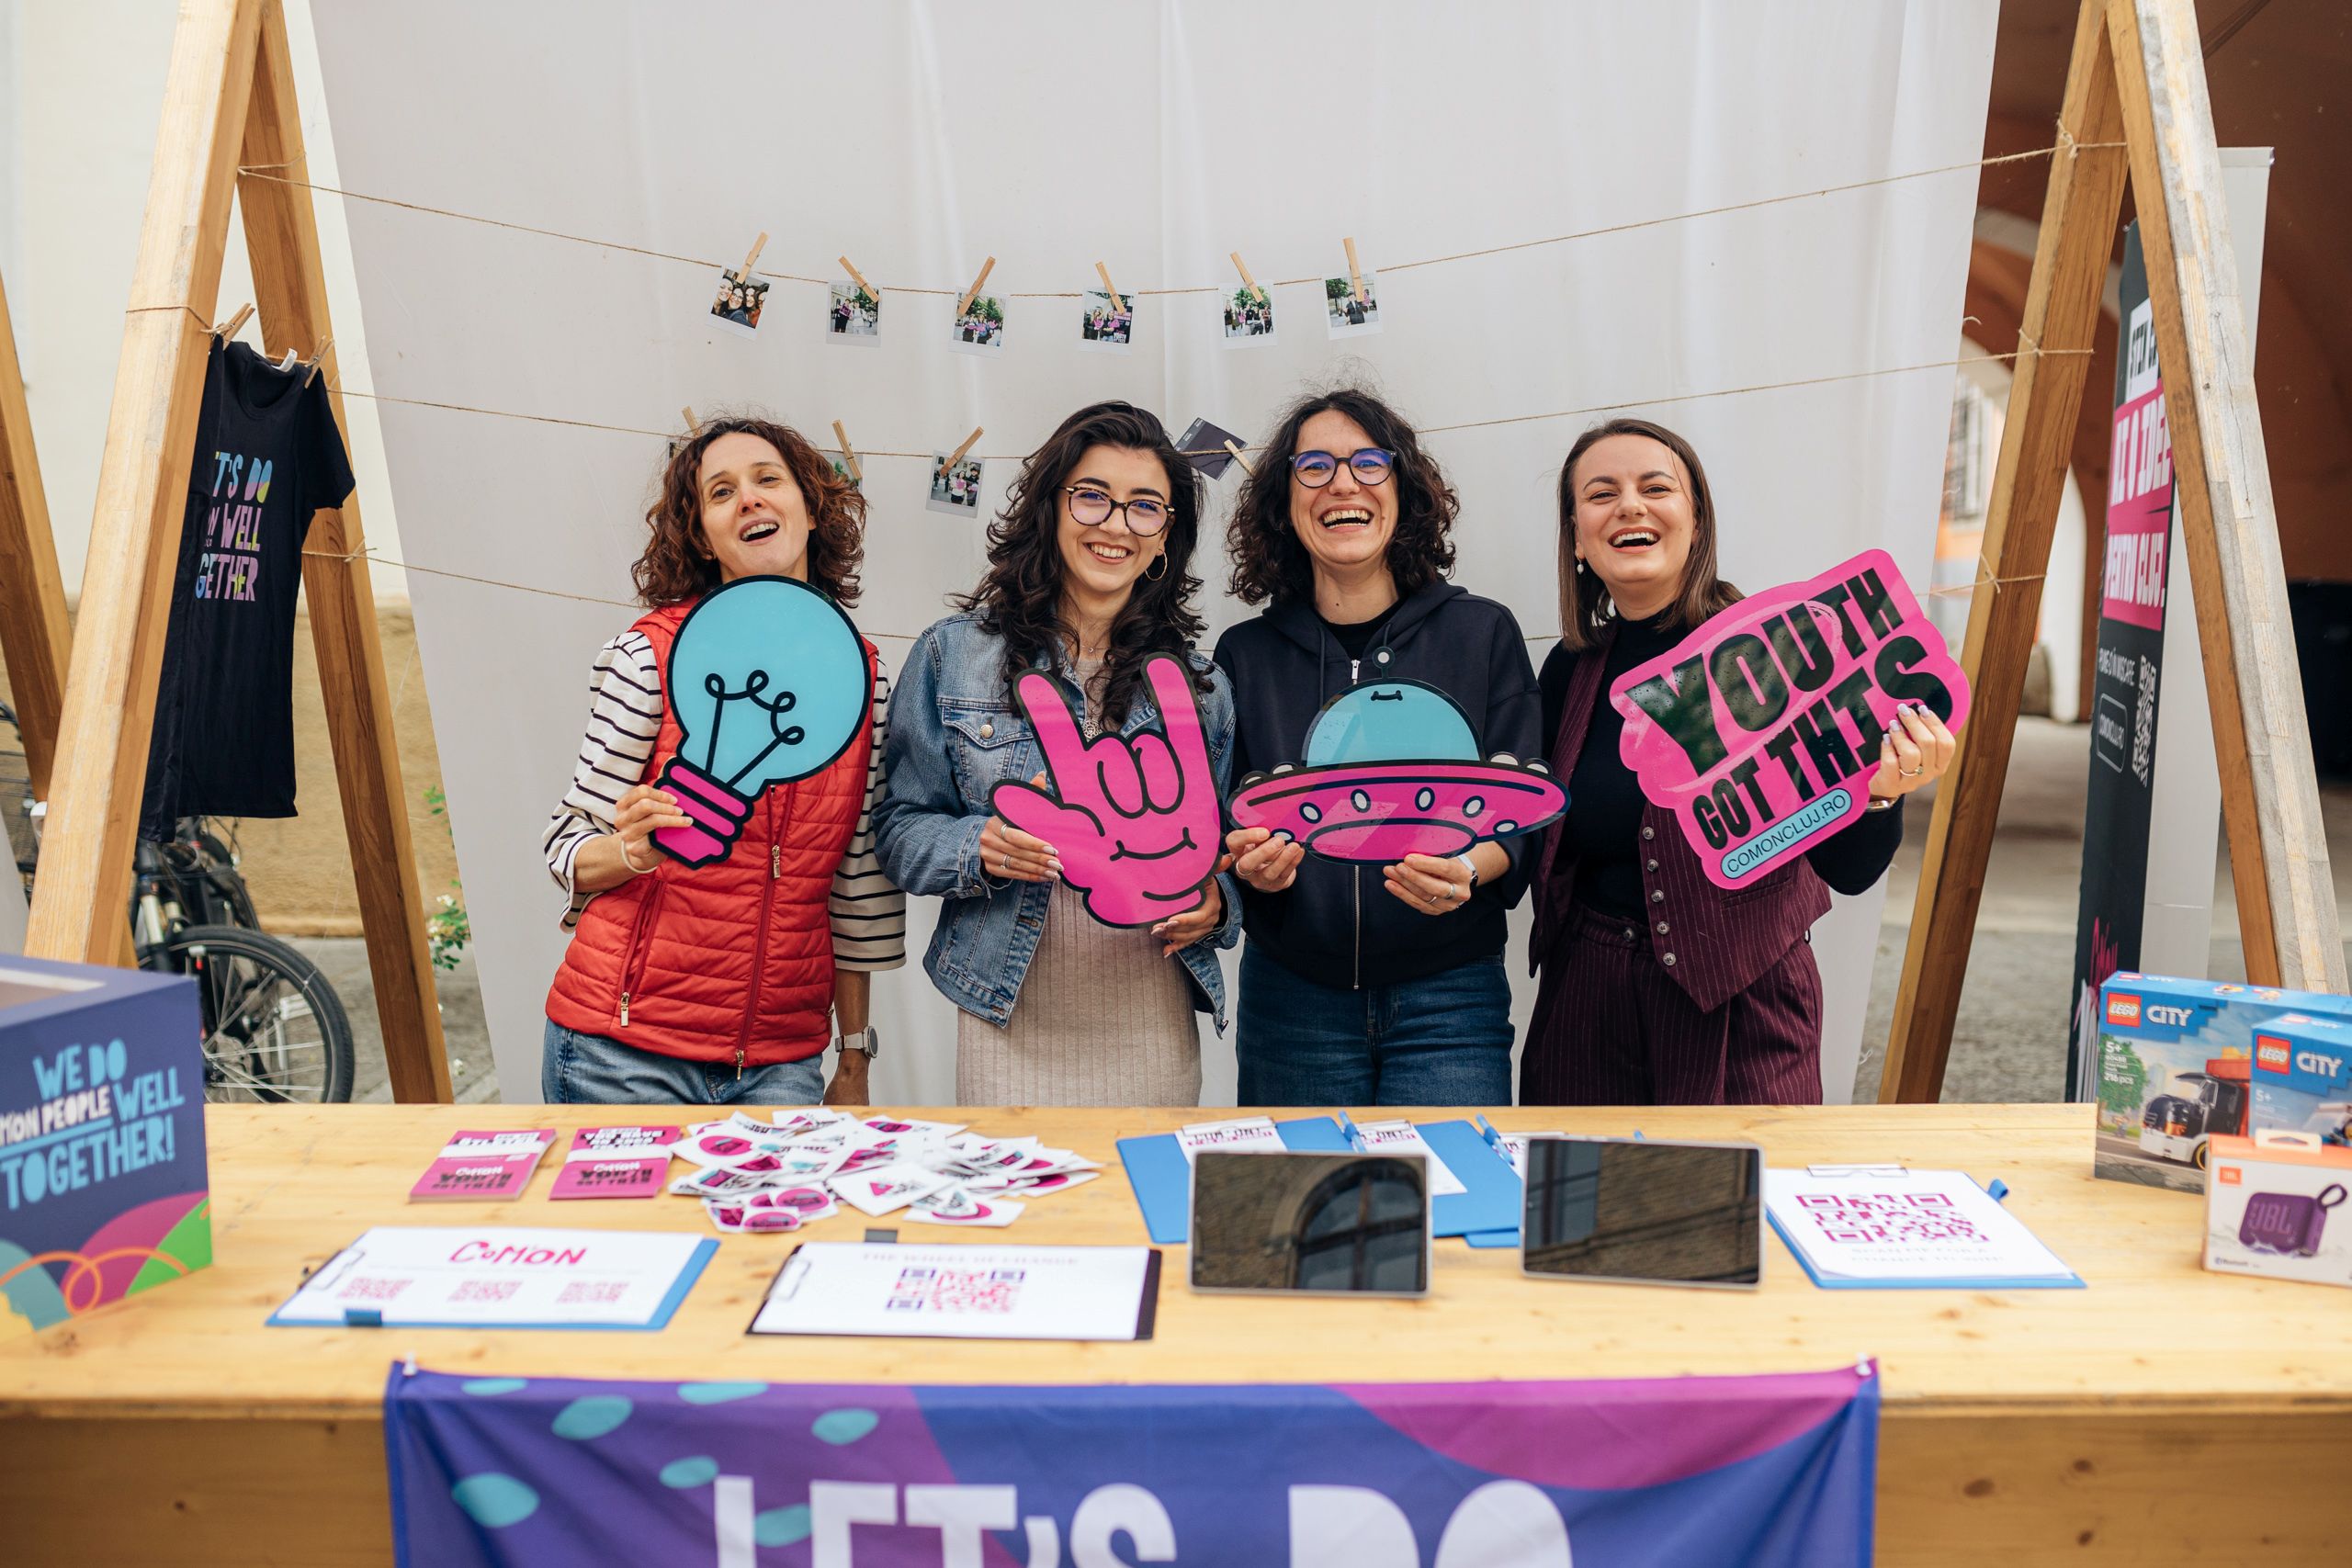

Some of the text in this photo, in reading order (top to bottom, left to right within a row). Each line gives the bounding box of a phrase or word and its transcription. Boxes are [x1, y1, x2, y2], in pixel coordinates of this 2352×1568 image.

[220, 502, 262, 551] WELL
[1624, 567, 1905, 778] YOUTH
[1692, 635, 1953, 850] GOT THIS
[1726, 794, 1848, 874] COMONCLUJ.RO
[2109, 1001, 2193, 1027] LEGO CITY
[32, 1037, 127, 1101] WE DO
[2105, 1041, 2122, 1054] 5+
[2258, 1044, 2343, 1078] LEGO CITY
[41, 1085, 111, 1135] PEOPLE
[112, 1066, 184, 1122] WELL
[2256, 1088, 2272, 1102] 5+
[0, 1113, 175, 1211] TOGETHER!
[2247, 1201, 2291, 1235] JBL
